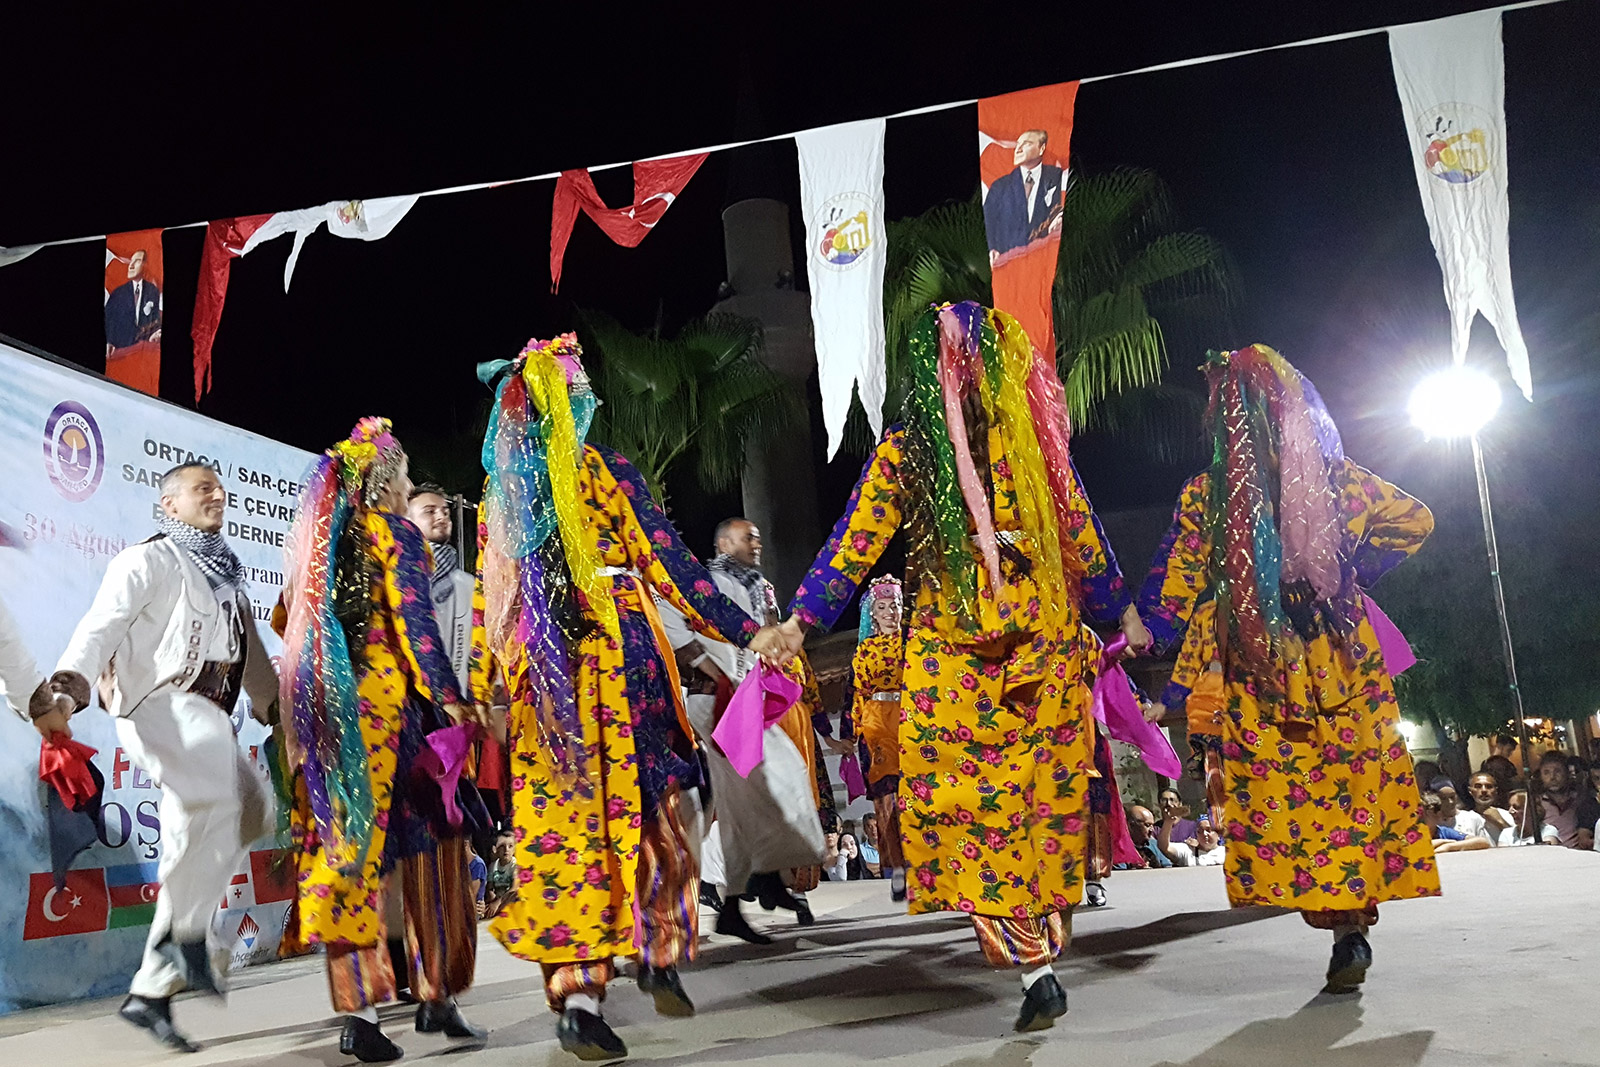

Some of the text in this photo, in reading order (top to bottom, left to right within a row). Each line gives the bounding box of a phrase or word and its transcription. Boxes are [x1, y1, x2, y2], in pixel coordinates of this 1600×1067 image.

[61, 416, 89, 433] ORTACA
[23, 512, 56, 543] 30
[227, 520, 285, 548] DERNE
